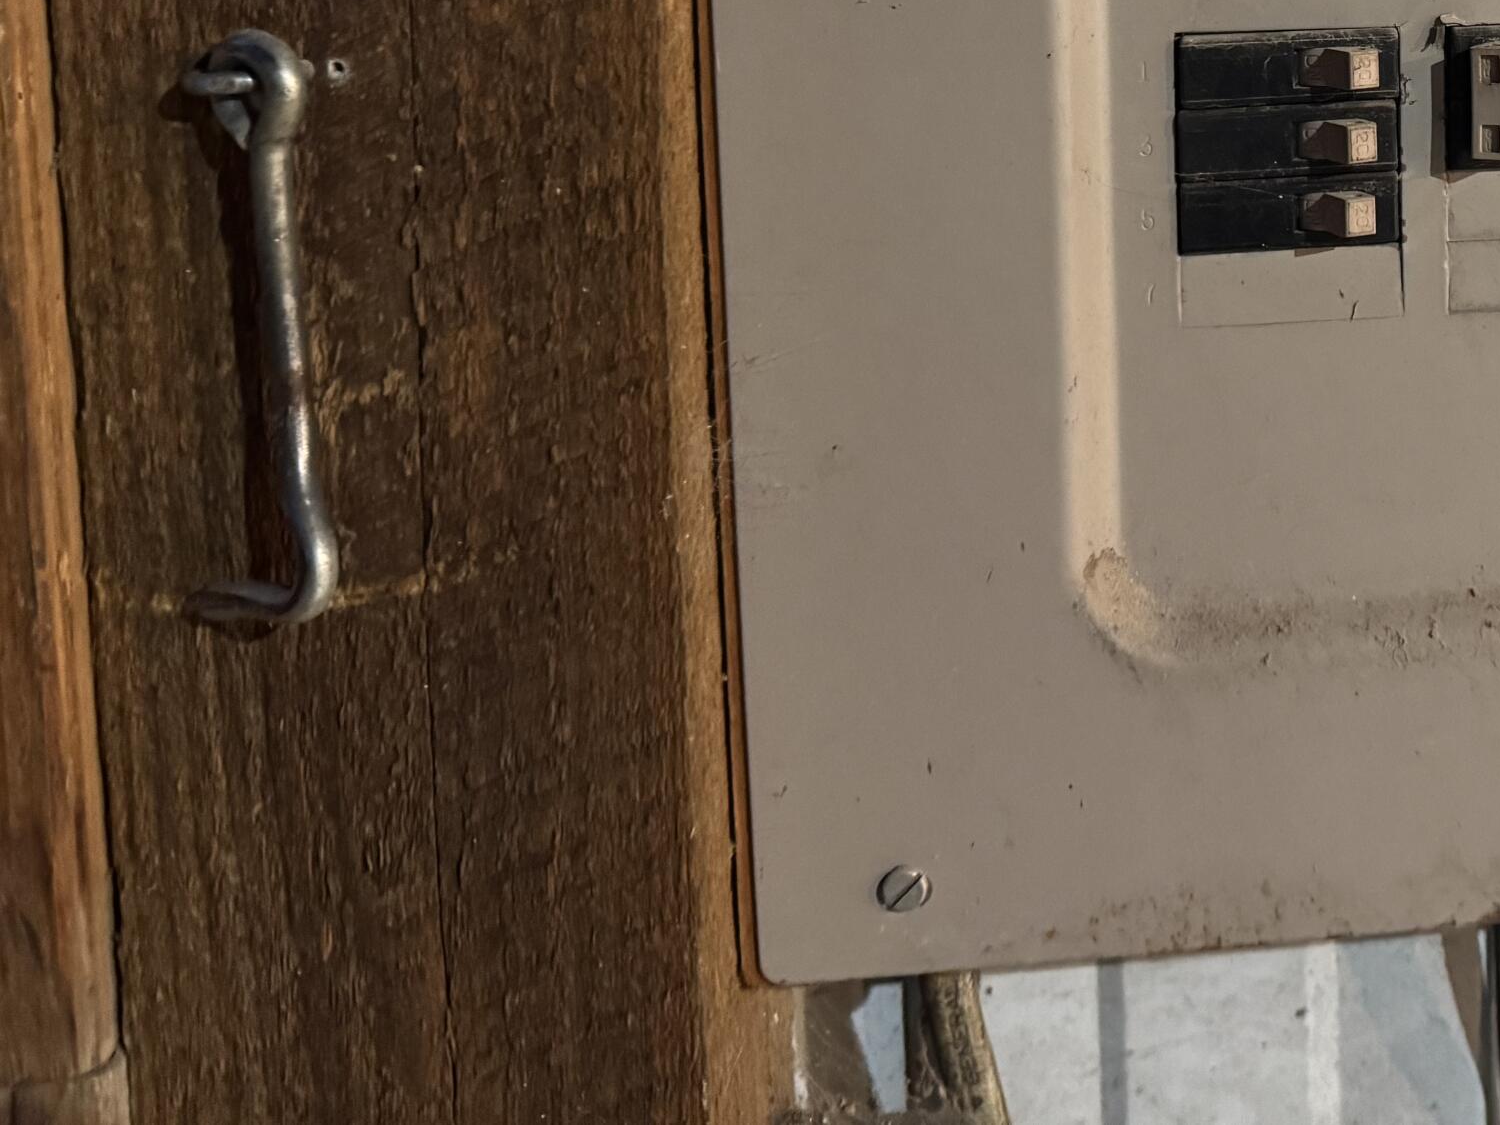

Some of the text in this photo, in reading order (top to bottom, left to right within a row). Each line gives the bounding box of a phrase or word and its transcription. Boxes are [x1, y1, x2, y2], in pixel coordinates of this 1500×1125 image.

[1137, 60, 1151, 83] 1
[1137, 135, 1153, 158] 3
[1355, 127, 1369, 154] 20
[1139, 209, 1155, 232] 5
[1354, 202, 1369, 229] 20
[1143, 282, 1157, 307] 7
